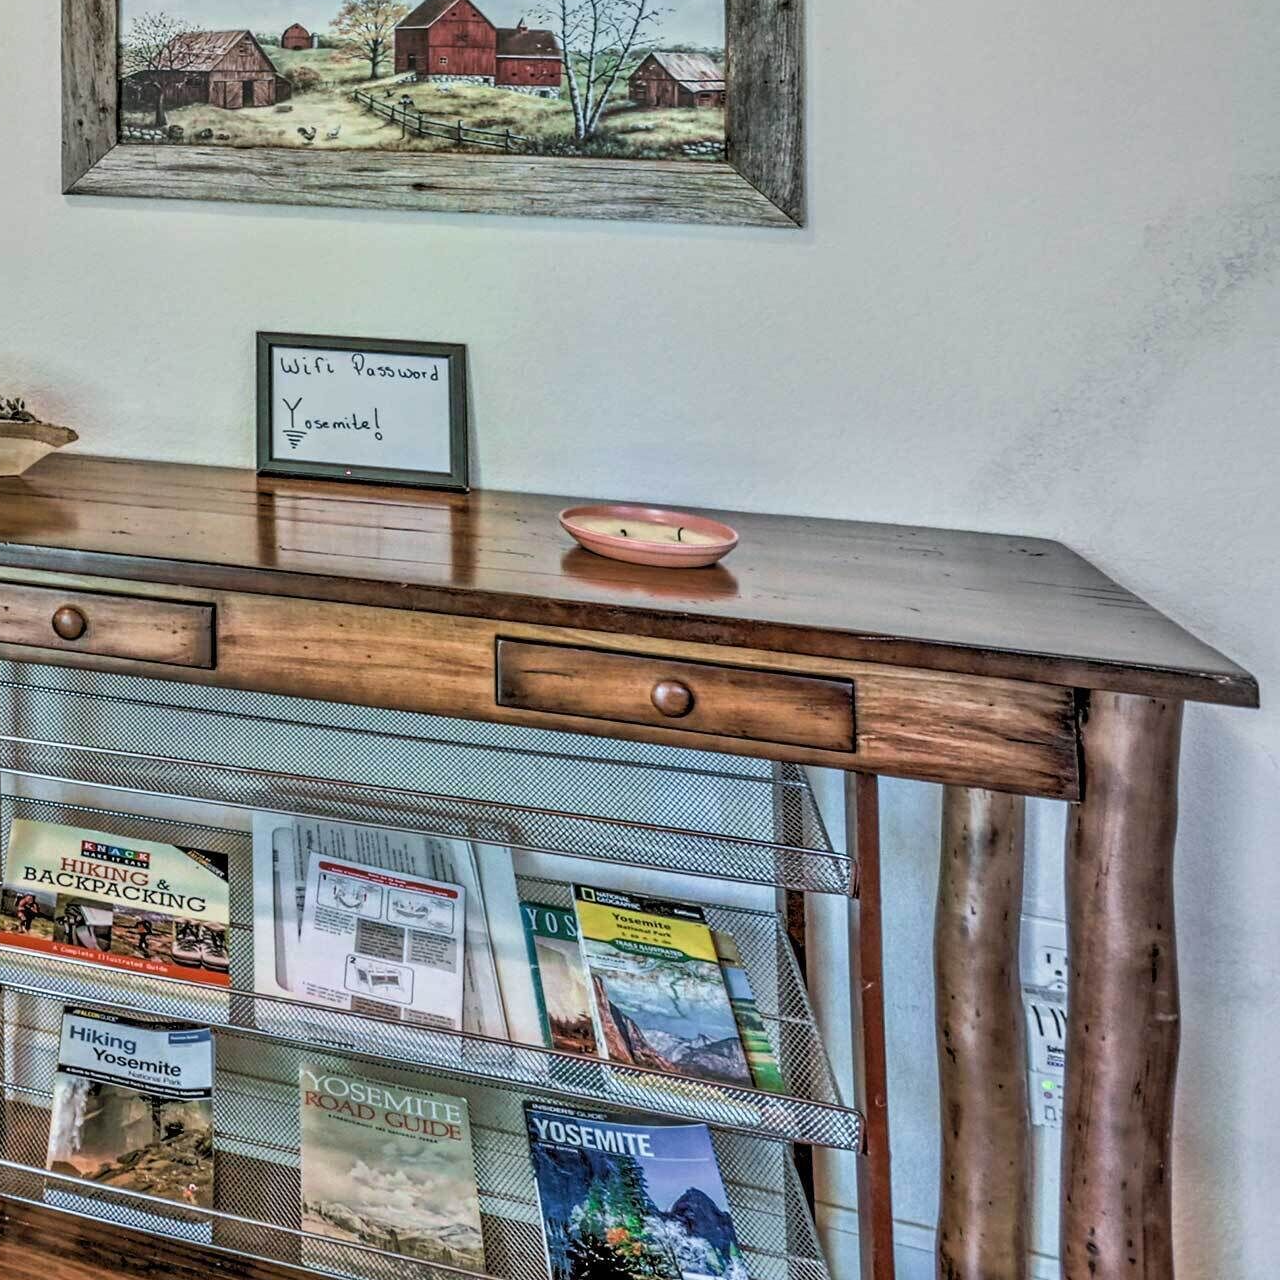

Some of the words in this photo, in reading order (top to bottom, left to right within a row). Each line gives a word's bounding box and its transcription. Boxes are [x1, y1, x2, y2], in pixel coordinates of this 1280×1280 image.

[351, 352, 439, 381] Password
[282, 396, 383, 442] Yosemite!
[83, 851, 108, 860] MAKE
[124, 859, 148, 868] EASY
[84, 842, 149, 862] KNACK
[60, 857, 149, 887] HIKING
[157, 879, 170, 891] &
[23, 866, 207, 913] BACKPACKING
[612, 912, 671, 930] Yosemite
[616, 923, 651, 934] National
[653, 930, 671, 938] Park
[70, 1025, 137, 1055] Hiking
[92, 1047, 182, 1077] Yosemite
[128, 1071, 161, 1083] National
[163, 1076, 183, 1086] Park
[303, 1071, 462, 1123] YOSEMITE
[305, 1090, 376, 1121] ROAD
[384, 1111, 462, 1141] GUIDE
[532, 1118, 655, 1158] YOSEMITE
